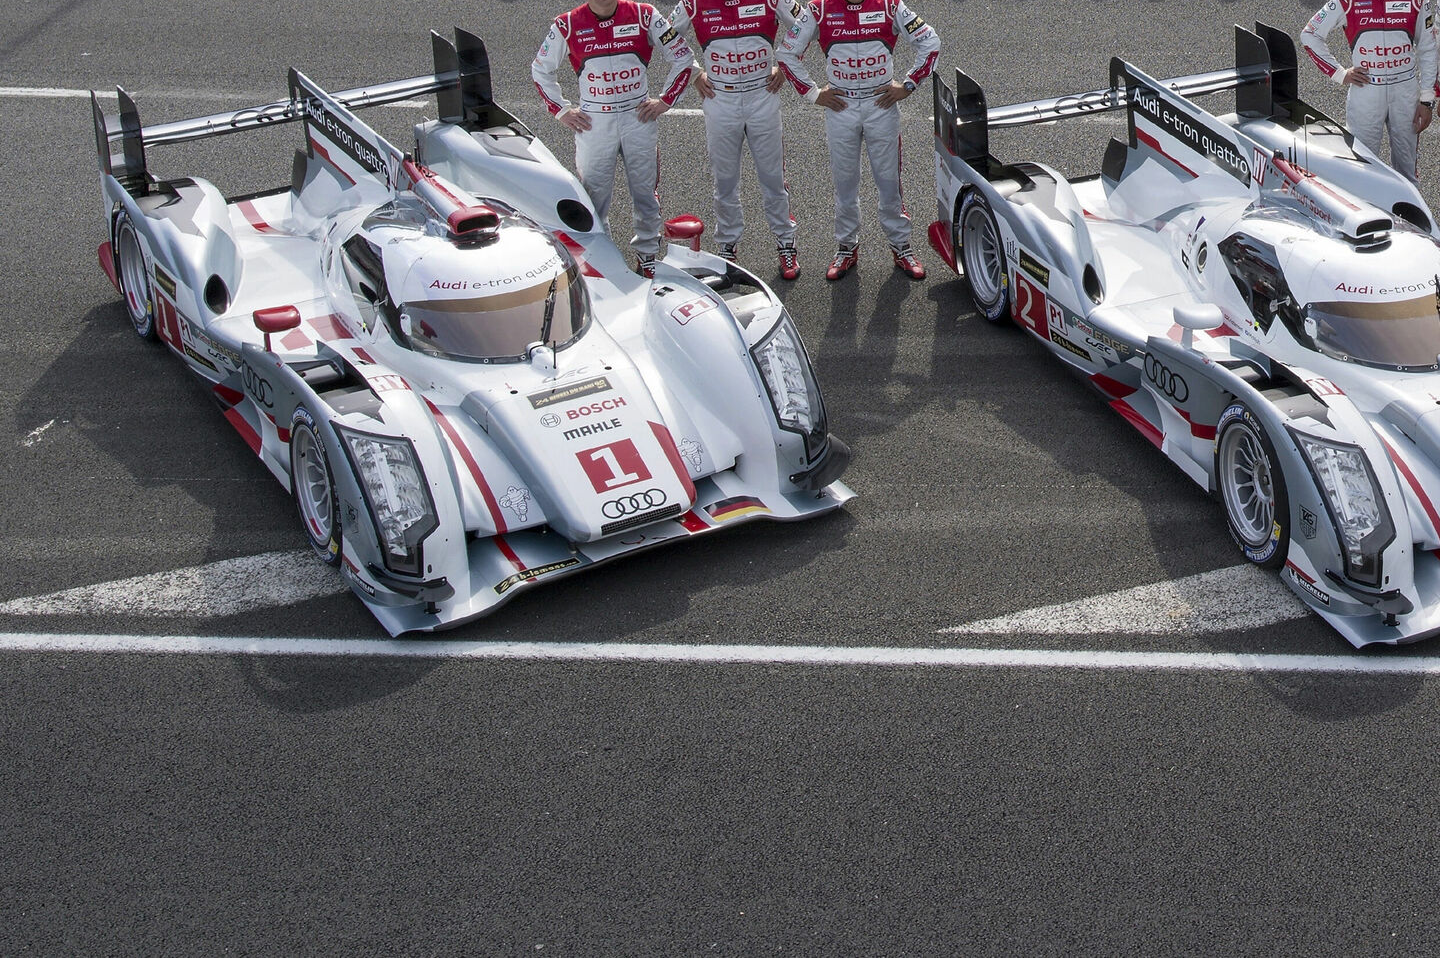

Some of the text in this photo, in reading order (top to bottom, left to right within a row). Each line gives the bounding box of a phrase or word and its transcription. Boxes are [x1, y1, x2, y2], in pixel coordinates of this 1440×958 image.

[738, 22, 760, 30] Sport
[860, 27, 881, 35] Sport
[593, 40, 634, 50] Audi Sport
[1359, 43, 1411, 57] e-tron
[711, 48, 768, 63] e-tron
[831, 53, 887, 68] e-tron
[1360, 56, 1411, 70] quattro
[587, 67, 641, 83] e-tron
[711, 61, 768, 75] quattro
[833, 67, 887, 81] quattro
[589, 81, 641, 96] quattro
[306, 99, 326, 126] Audi
[326, 119, 354, 149] e-tron
[354, 141, 388, 178] quattro
[1134, 88, 1248, 174] Audi e-tron quattro
[1309, 200, 1332, 224] Sport
[429, 253, 563, 290] Audi e-tron quattro
[1335, 281, 1426, 295] Audi e-tron
[678, 299, 710, 318] P1
[1020, 280, 1035, 328] 2
[158, 297, 173, 342] 1
[1050, 303, 1064, 329] P1
[1094, 330, 1130, 355] EDGE
[565, 396, 628, 421] BOSCH
[563, 418, 622, 441] MAHLE
[590, 446, 640, 488] 1
[1300, 578, 1329, 602] MICHELIN
